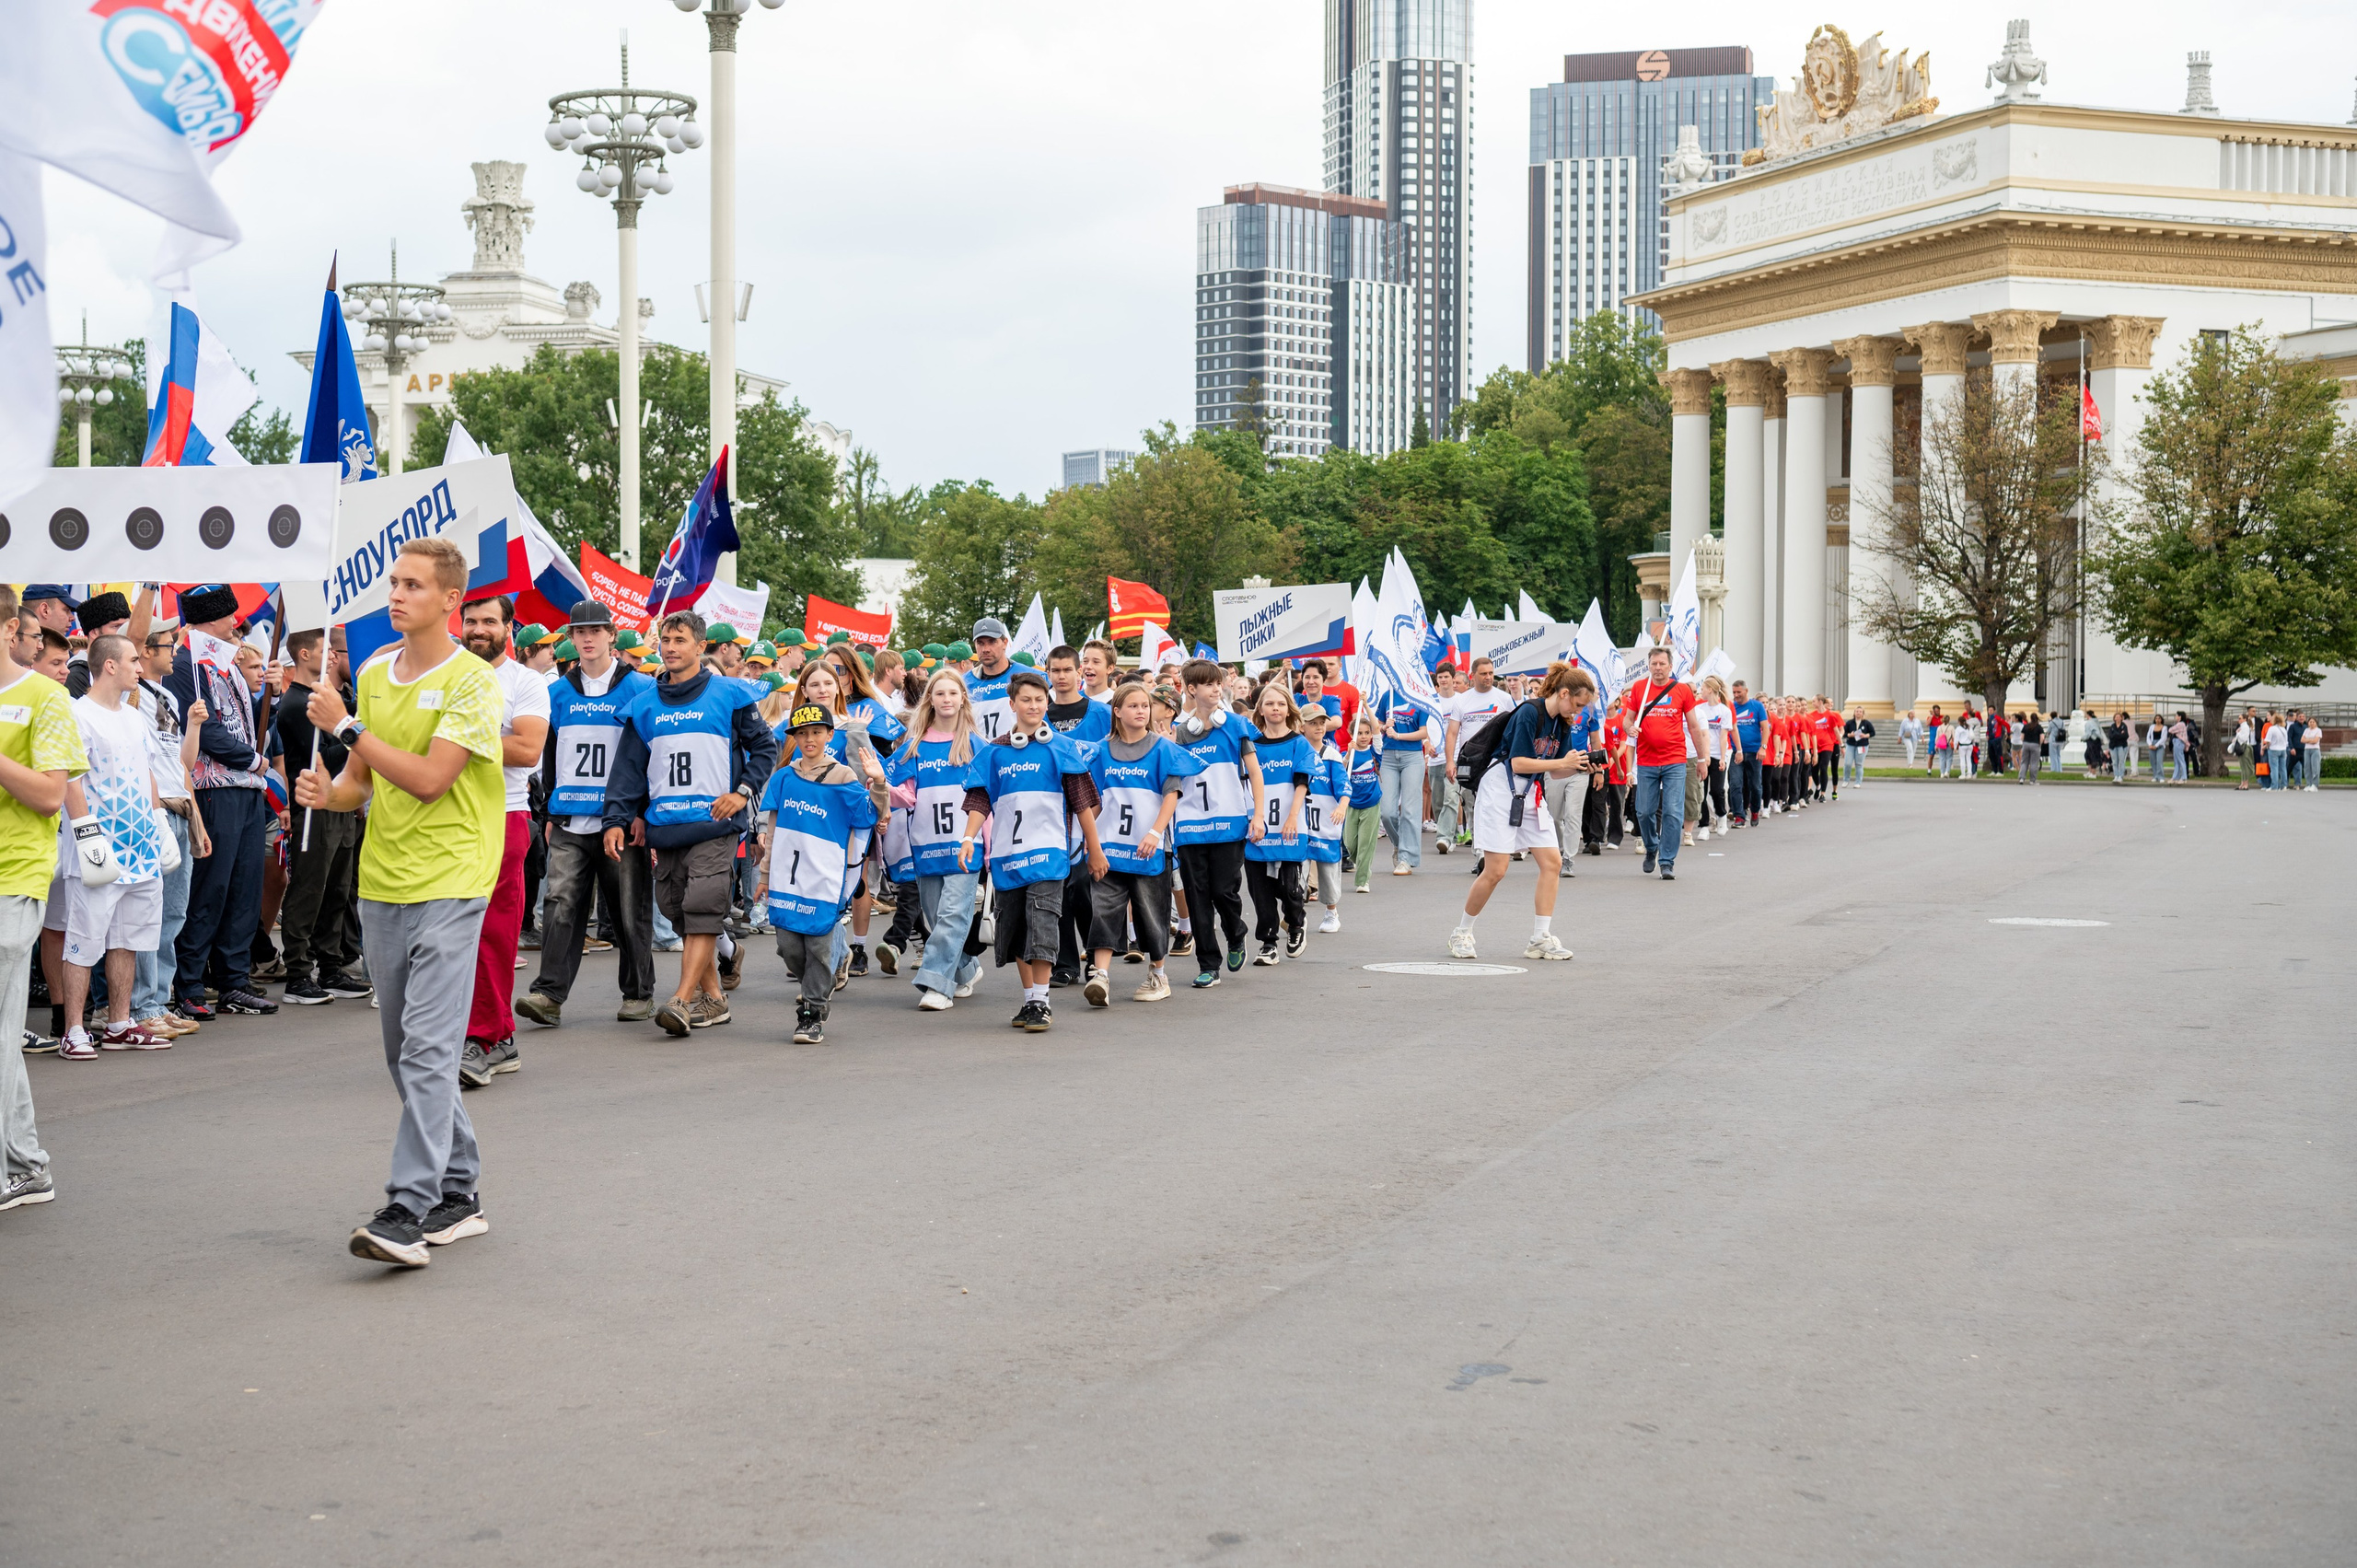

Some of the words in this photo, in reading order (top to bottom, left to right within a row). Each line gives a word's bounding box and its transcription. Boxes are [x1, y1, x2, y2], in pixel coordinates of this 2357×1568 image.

[1759, 158, 1893, 206] РОССИЙСКАЯ
[1734, 196, 1807, 228] СОВЕТСКАЯ
[1814, 166, 1926, 205] ФЕДЕРАТИВНАЯ
[1734, 204, 1845, 244] СОЦИАЛИСТИЧЕСКАЯ
[1852, 183, 1927, 215] РЕСПУБЛИКА
[323, 478, 457, 615] СНОУБОРД
[618, 586, 631, 598] НЕ
[630, 590, 648, 607] ПАД
[1239, 592, 1293, 639] ЛЫЖНЫЕ
[1239, 622, 1275, 657] ГОНКИ
[1488, 625, 1545, 659] КОНЬКОБЕЖНЫЙ
[1492, 654, 1509, 669] ПОРТ
[1625, 657, 1645, 674] ИГУРНОЕ
[973, 681, 1010, 694] playToday
[570, 702, 616, 716] playToday
[655, 710, 703, 726] playToday
[792, 713, 823, 726] WARS
[794, 706, 820, 718] STAR
[983, 712, 1000, 738] 17
[575, 743, 606, 777] 20
[669, 751, 691, 786] 18
[998, 761, 1040, 778] playToday
[1105, 766, 1148, 781] playToday
[558, 792, 599, 802] МОСКОВСКИЙ
[784, 797, 828, 819] playToday
[1196, 781, 1209, 811] 7
[933, 802, 954, 835] 15
[1119, 804, 1132, 836] 5
[1268, 797, 1280, 826] 8
[1012, 810, 1023, 845] 2
[1178, 820, 1215, 833] МОСКОВСКИЙ
[1216, 821, 1231, 830] СПОРТ
[789, 850, 800, 886] 1
[1029, 854, 1050, 865] СПОРТ
[796, 903, 818, 916] СПОРТ
